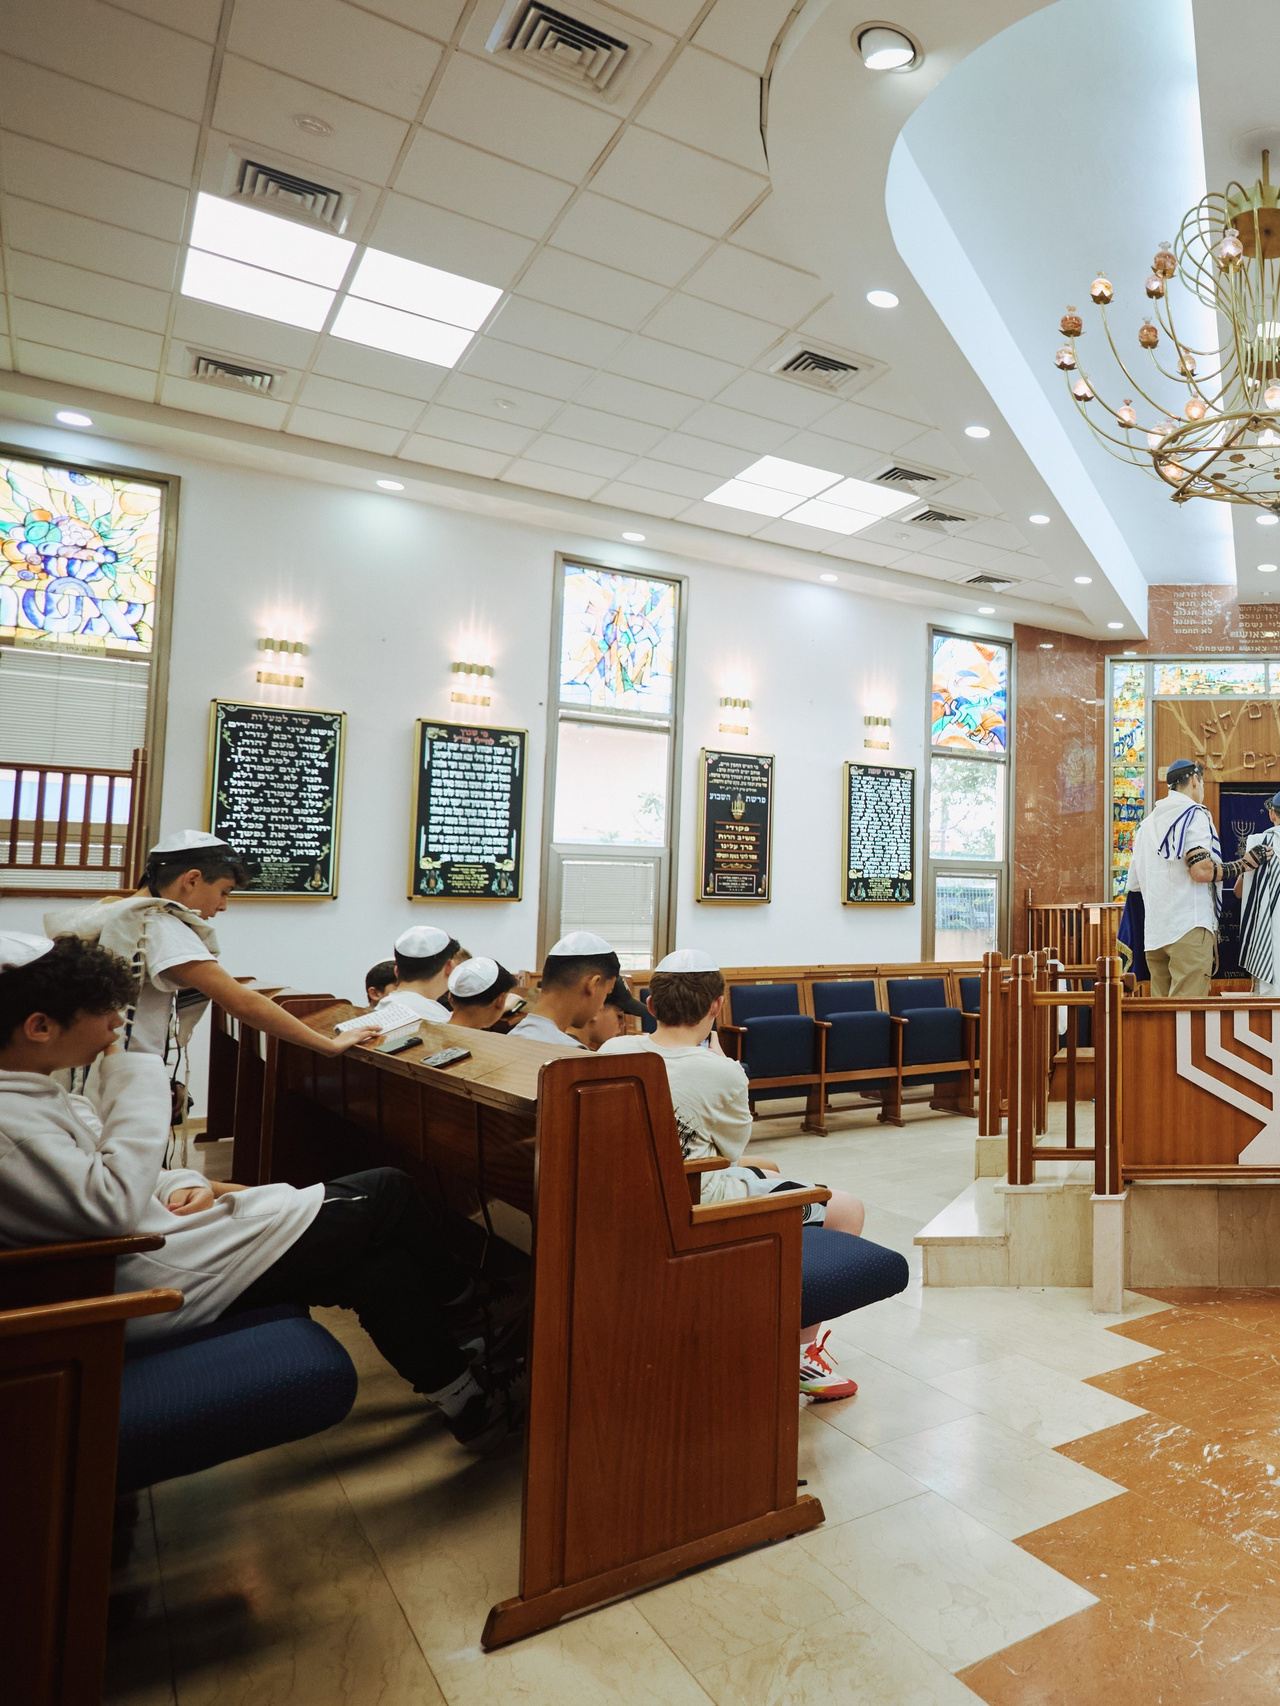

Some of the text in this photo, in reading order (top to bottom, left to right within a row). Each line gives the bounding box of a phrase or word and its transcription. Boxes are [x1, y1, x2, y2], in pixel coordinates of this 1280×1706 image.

[292, 717, 310, 725] שיר
[267, 723, 282, 732] אל
[296, 735, 320, 743] מאין
[314, 759, 329, 768] אל
[233, 771, 253, 779] ולא
[304, 767, 319, 775] אל
[270, 782, 299, 790] שומר
[299, 791, 323, 799] יהוה
[302, 799, 323, 808] צלך
[746, 795, 766, 804] פרשת
[253, 805, 289, 813] השמש
[240, 820, 263, 829] מכל
[268, 823, 303, 831] ישמרך
[307, 824, 331, 832] יהוה
[250, 847, 282, 855] מעתה
